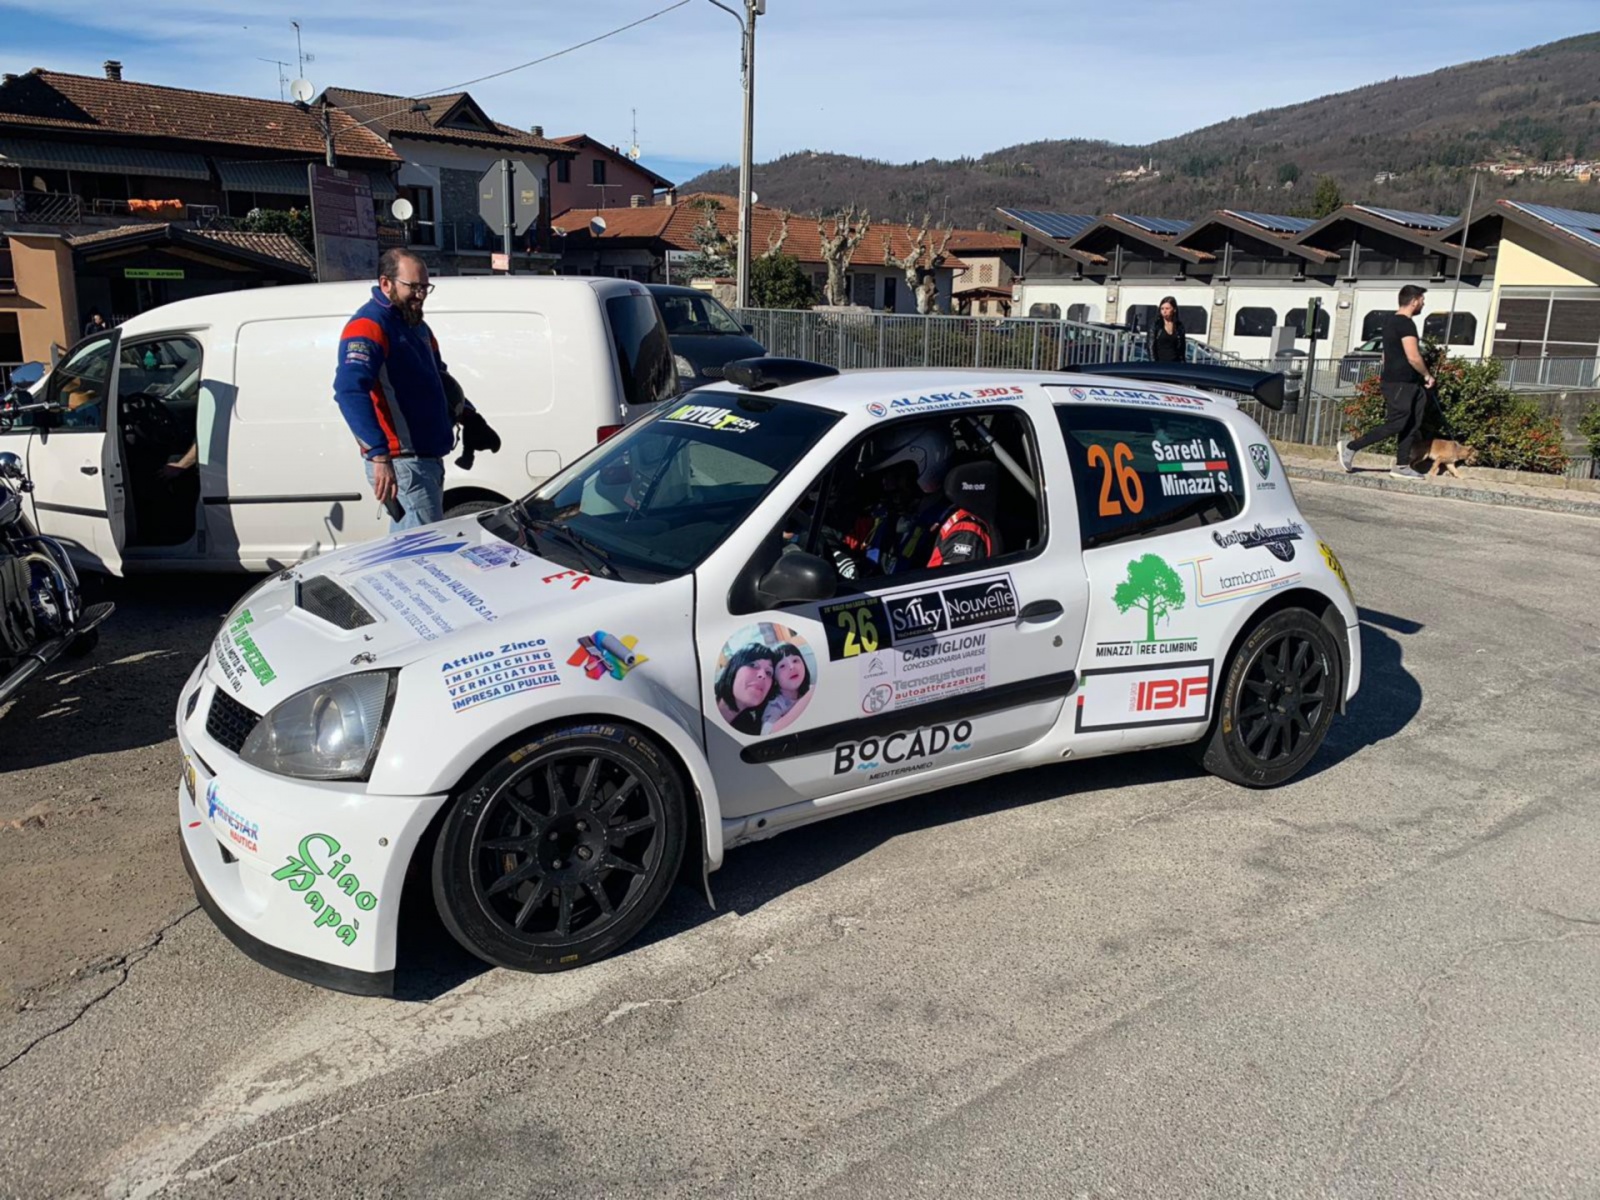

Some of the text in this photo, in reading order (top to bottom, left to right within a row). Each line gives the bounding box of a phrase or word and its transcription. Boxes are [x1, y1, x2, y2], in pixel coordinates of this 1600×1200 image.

[890, 385, 1024, 408] ALASKA 390 S
[1089, 388, 1161, 401] ALASKA
[1159, 394, 1191, 405] 390
[1152, 438, 1227, 462] Saredi A.
[1087, 441, 1145, 517] 26
[1160, 471, 1233, 497] Minazzi S.
[1219, 566, 1276, 589] tamborini
[447, 580, 484, 607] VALVANO
[947, 591, 1014, 616] Nouvelle
[893, 601, 943, 631] Silky
[838, 608, 879, 657] 26
[441, 638, 546, 672] Attilio Zinco
[903, 634, 986, 662] CASTIGLIONI
[903, 648, 986, 672] CONCESSIONARIA VARESE
[1096, 645, 1133, 657] MINAZZI
[1159, 642, 1198, 654] CLIMBING
[445, 652, 551, 686] IMBIANCHINO
[449, 662, 556, 697] VERNICIATORE
[453, 674, 560, 710] IMPRESA DI PULIZIA
[895, 674, 986, 699] autoattrezzature
[1136, 676, 1209, 712] IBF
[869, 761, 933, 781] MEDITERRANEO
[230, 829, 258, 853] NAUTICA
[298, 833, 379, 911] Ciao
[271, 856, 359, 946] Papà
